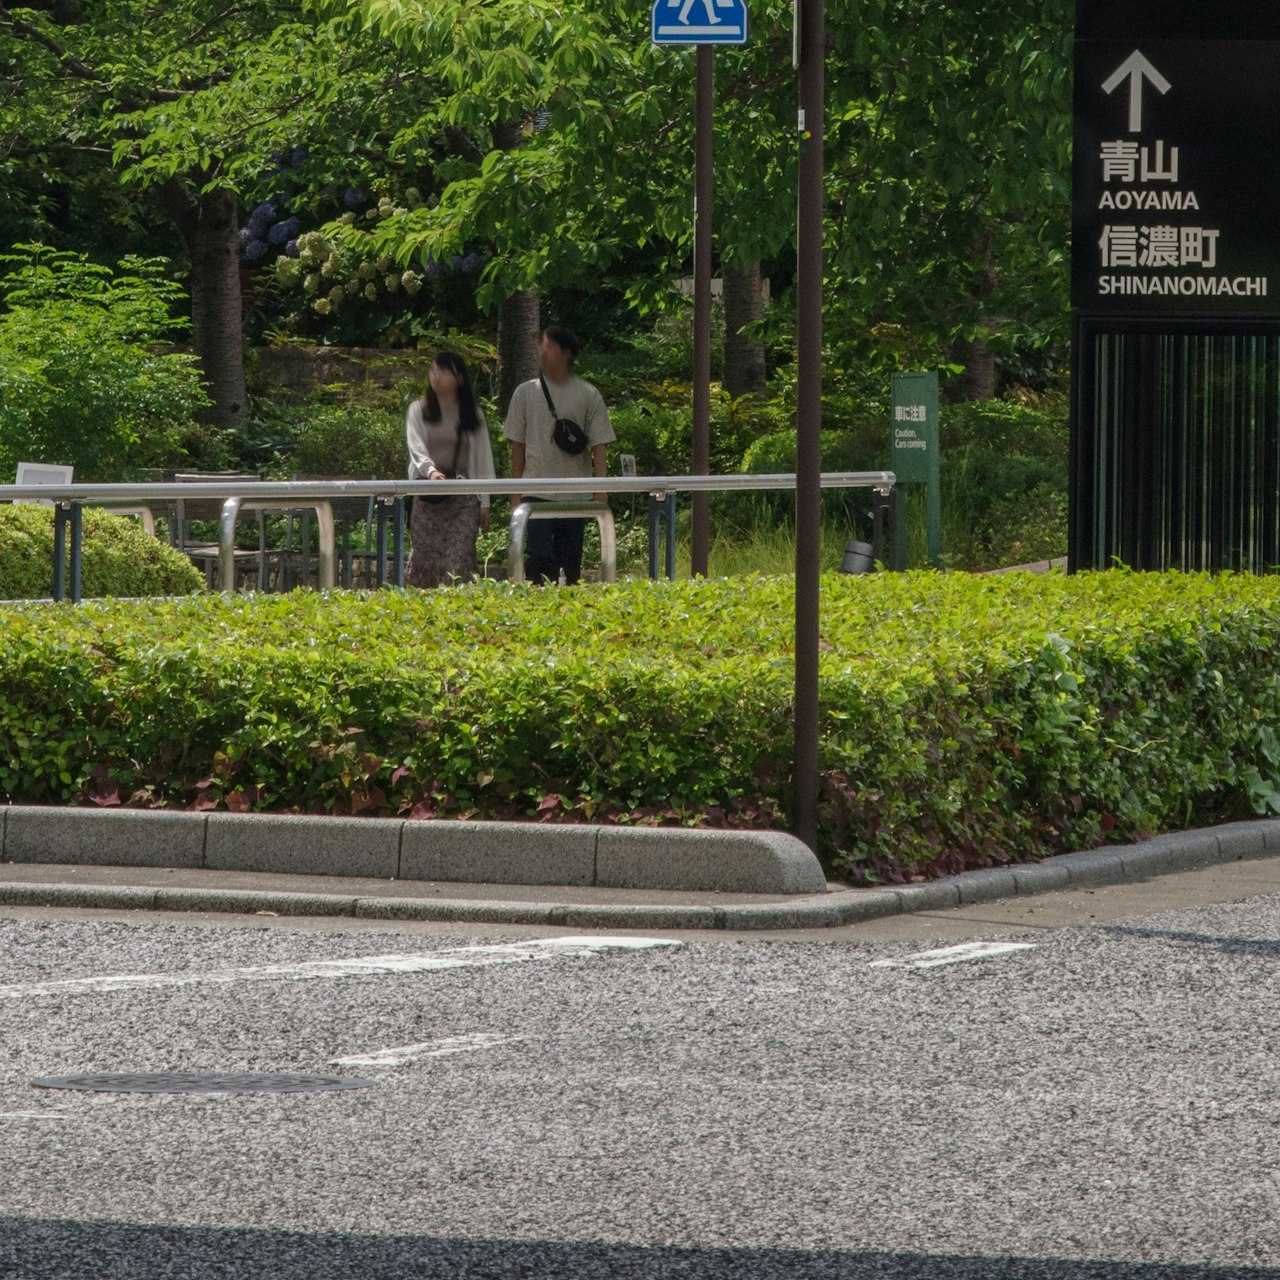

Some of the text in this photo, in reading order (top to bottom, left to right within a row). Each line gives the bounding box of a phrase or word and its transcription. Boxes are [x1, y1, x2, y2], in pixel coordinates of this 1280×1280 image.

[1099, 139, 1179, 183] 青山
[1098, 190, 1200, 210] AOYAMA
[1098, 224, 1220, 268] 信濃町
[1098, 275, 1267, 296] SHINANOMACHI
[895, 405, 926, 422] 車に注意
